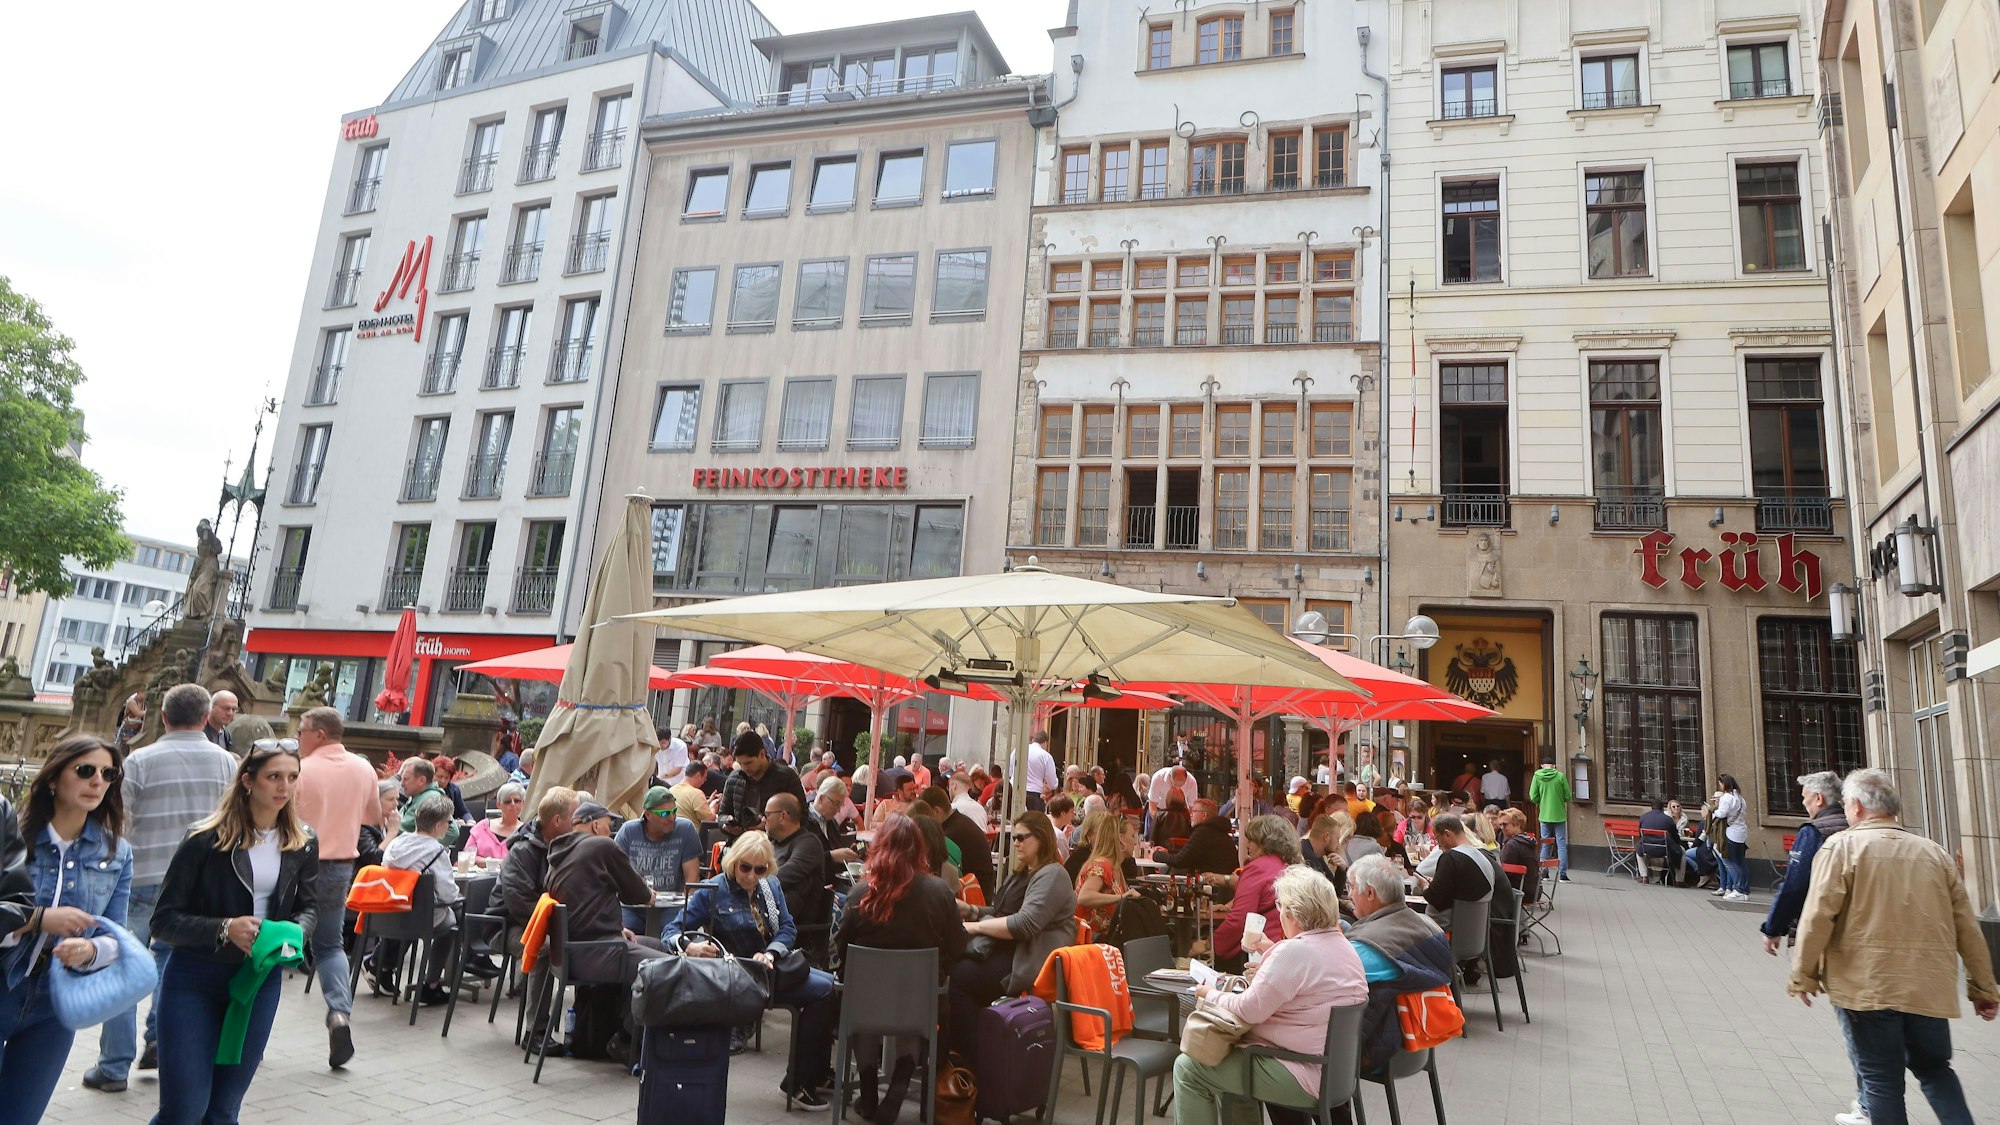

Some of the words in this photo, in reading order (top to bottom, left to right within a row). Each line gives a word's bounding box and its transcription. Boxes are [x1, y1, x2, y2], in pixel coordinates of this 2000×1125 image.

[692, 466, 910, 488] FEINKOSTTHEKE
[1633, 528, 1823, 603] früh
[415, 636, 443, 658] früh
